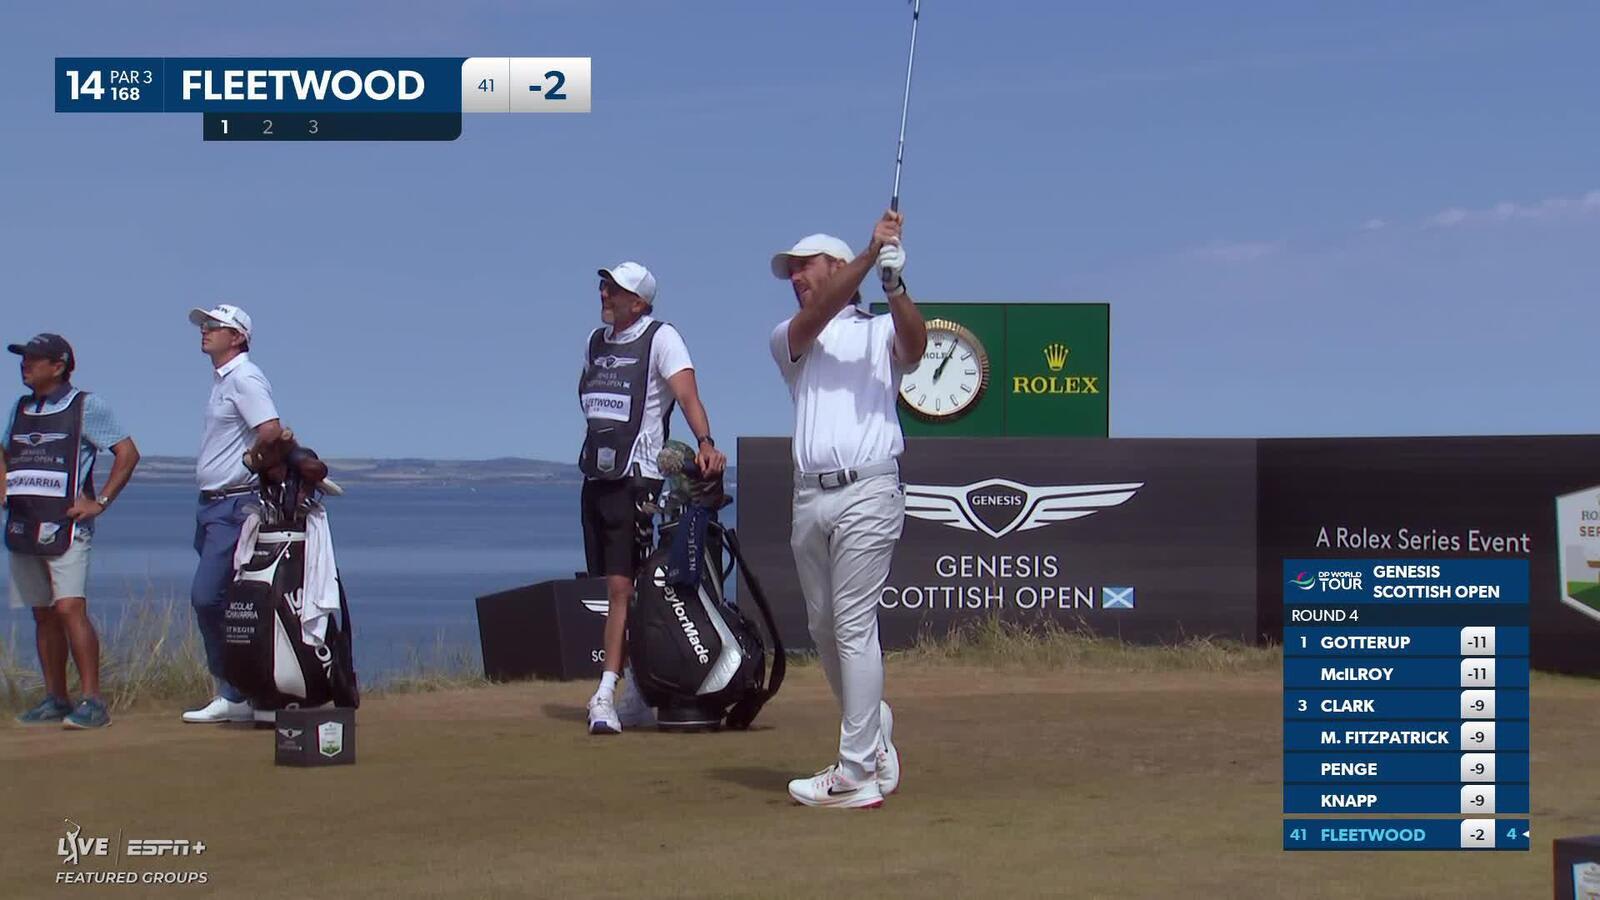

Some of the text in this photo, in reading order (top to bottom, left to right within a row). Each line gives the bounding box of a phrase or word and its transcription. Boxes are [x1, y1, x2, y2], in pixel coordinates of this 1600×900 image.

[1012, 376, 1100, 394] ROLEX
[972, 495, 1022, 506] GENESIS
[1316, 526, 1531, 553] A Rolex Series Event
[935, 555, 1059, 578] GENESIS
[878, 586, 1094, 609] COTTISH OPEN
